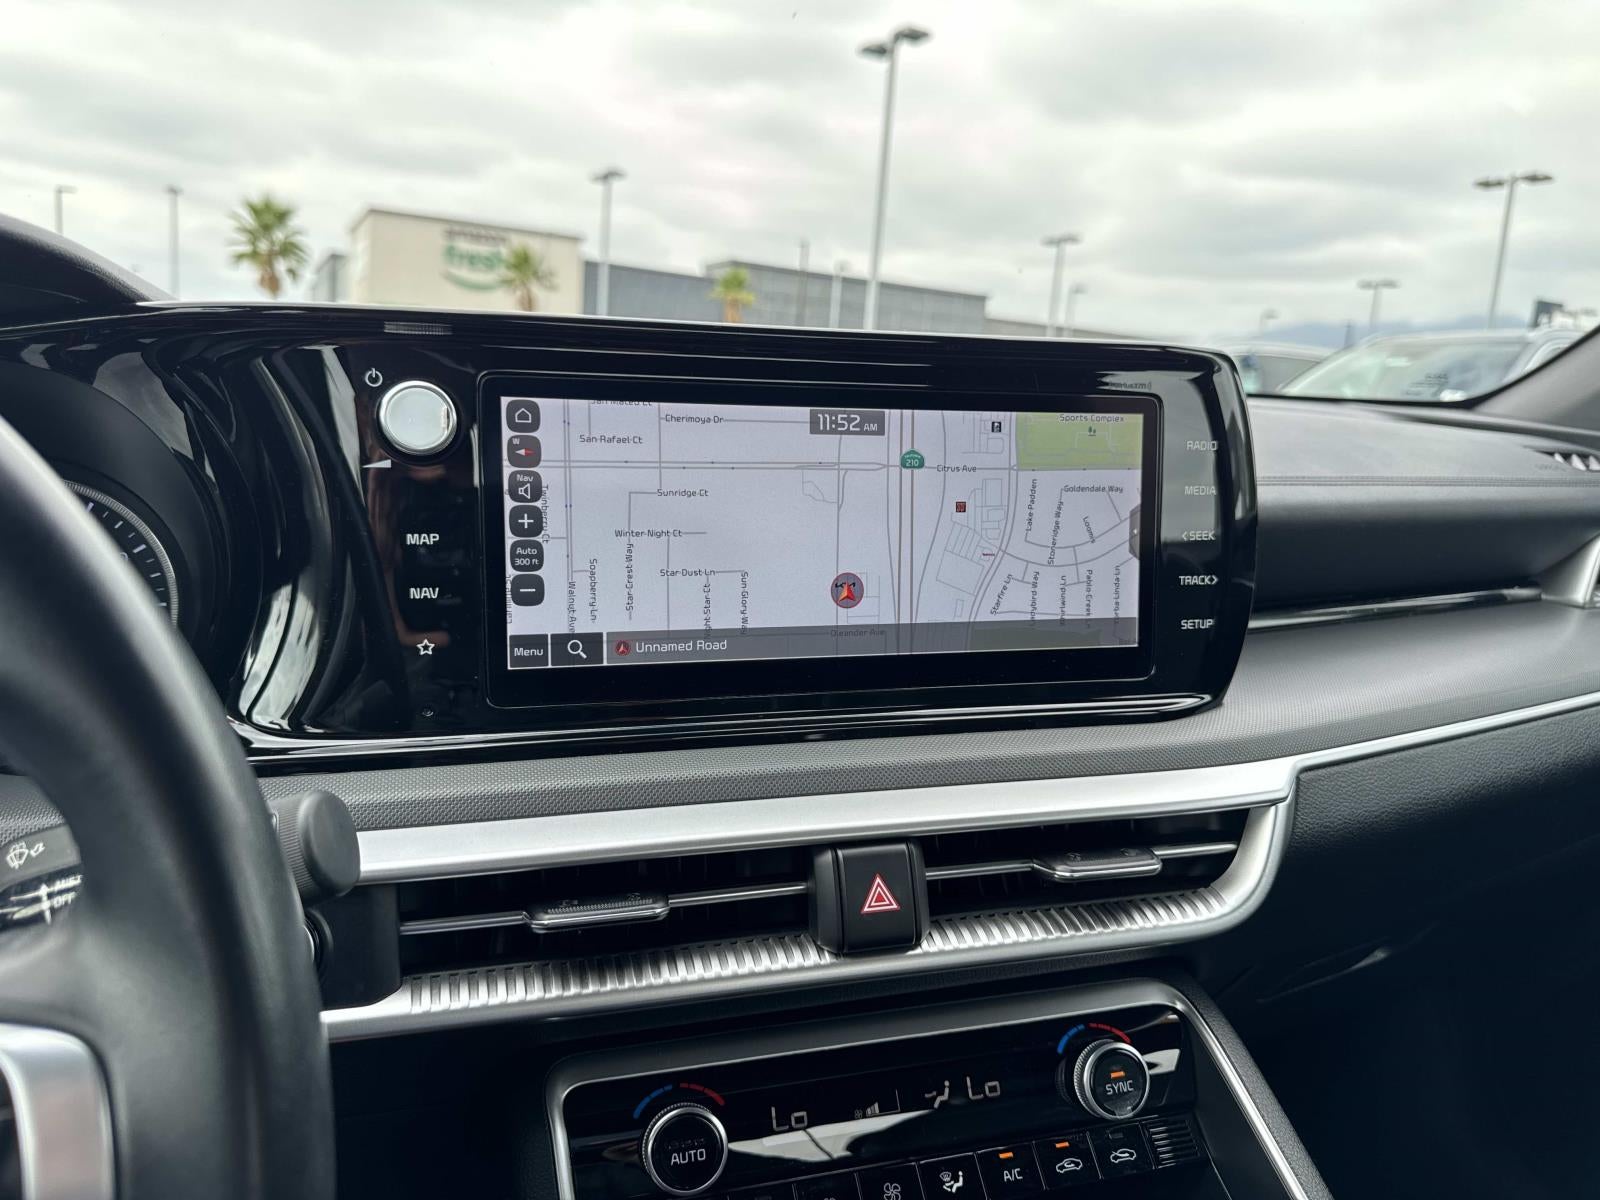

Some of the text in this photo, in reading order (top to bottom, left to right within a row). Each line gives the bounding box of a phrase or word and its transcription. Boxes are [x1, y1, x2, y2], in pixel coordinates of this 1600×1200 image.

[665, 414, 724, 424] Cherimoya Dr
[818, 414, 860, 430] 11:52
[1059, 414, 1124, 424] Sports Complex
[580, 434, 643, 444] San Rafael Ct
[1186, 441, 1218, 451] RADIO
[906, 459, 919, 467] 210
[516, 474, 534, 482] Nav
[657, 489, 709, 498] Sunridge Ct
[1184, 486, 1217, 496] MEDIA
[1026, 478, 1037, 532] Lake Padden
[614, 530, 644, 538] Winter
[647, 530, 670, 538] Night
[1048, 501, 1064, 564] Stoneridge Way
[1189, 530, 1216, 540] SEEK
[406, 533, 440, 545] MAP
[514, 558, 531, 566] 300
[626, 543, 634, 611] Star Crest Way
[740, 572, 748, 589] Sun
[1179, 575, 1212, 586] TRACK
[410, 588, 439, 600] NAV
[589, 558, 598, 620] Soapberry Ln
[704, 584, 710, 594] Ct
[568, 582, 576, 614] Walnut
[740, 590, 748, 614] Glory
[990, 585, 1008, 616] Starfire
[1180, 619, 1213, 630] SETUP
[514, 647, 544, 656] Menu
[636, 640, 727, 652] Unnamed Road
[966, 1076, 1000, 1100] Lo
[1105, 1080, 1134, 1096] SYNC
[771, 1106, 808, 1132] Lo
[670, 1148, 706, 1166] AUTO
[1003, 1168, 1023, 1182] A/C
